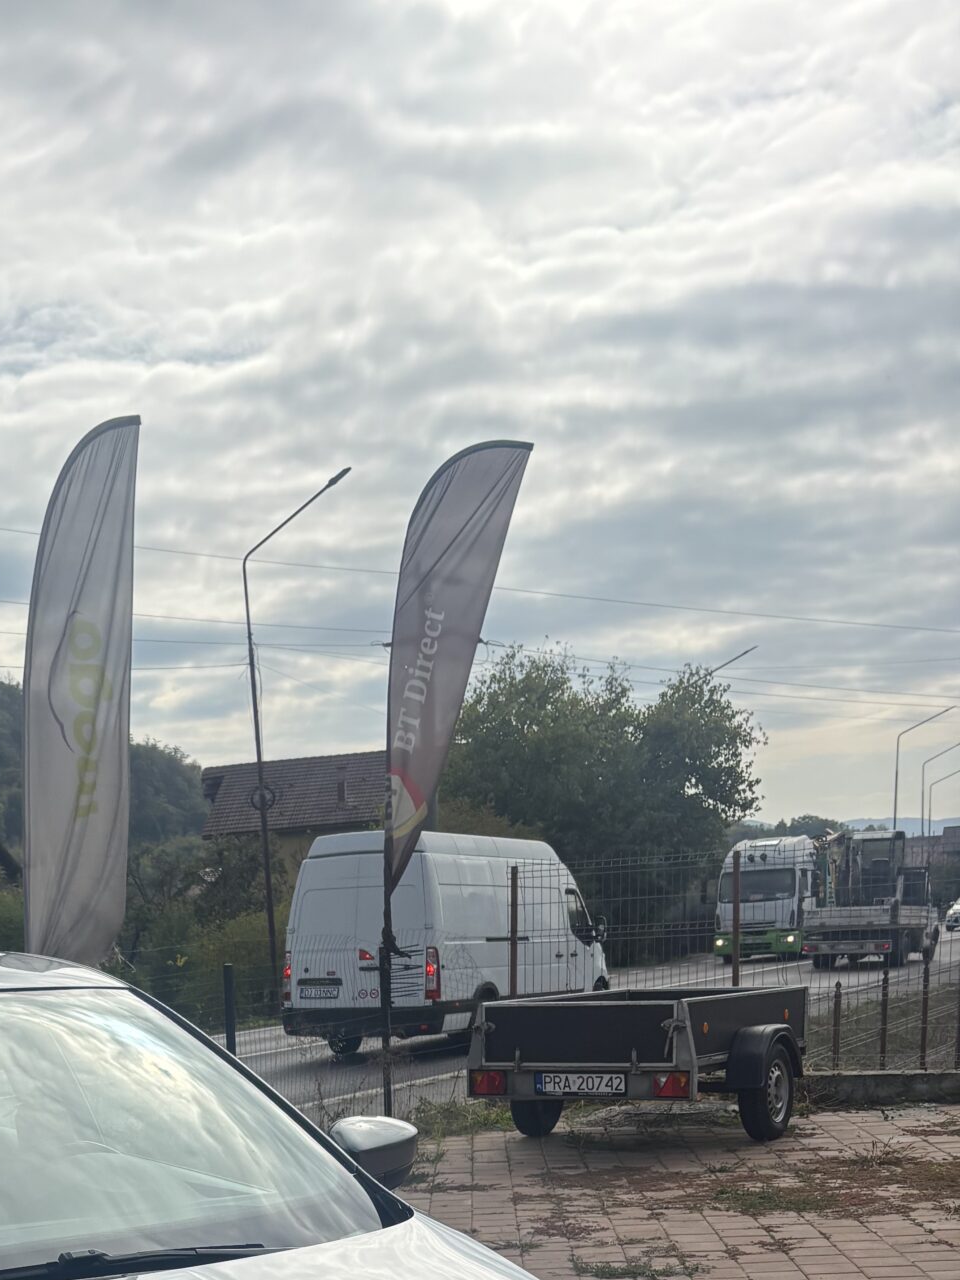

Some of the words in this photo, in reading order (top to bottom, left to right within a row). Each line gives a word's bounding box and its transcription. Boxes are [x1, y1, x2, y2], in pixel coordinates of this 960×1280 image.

[403, 607, 445, 705] Direct
[393, 707, 421, 755] BT
[543, 1074, 572, 1091] PRA
[577, 1074, 624, 1092] 20742
